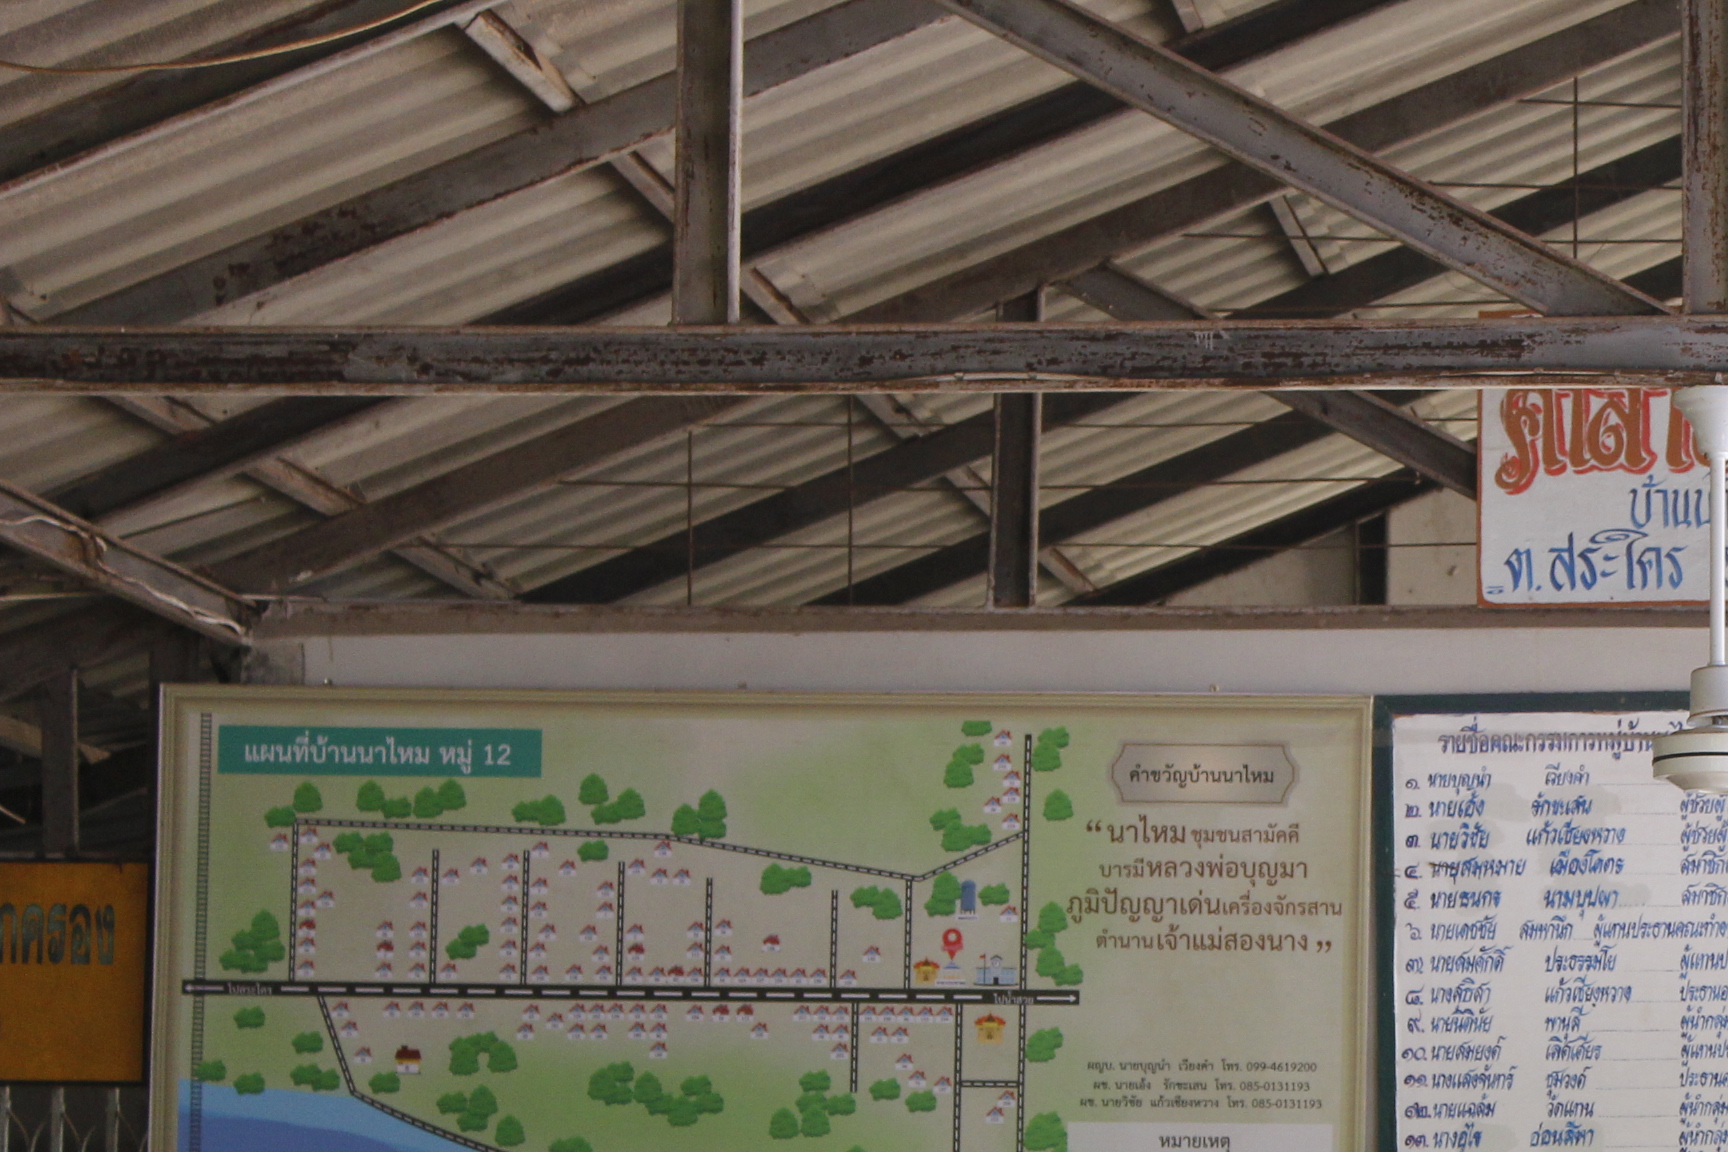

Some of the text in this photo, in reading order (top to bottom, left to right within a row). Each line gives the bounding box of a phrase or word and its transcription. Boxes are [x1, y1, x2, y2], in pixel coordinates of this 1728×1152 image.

[245, 731, 511, 775] แผนที่บ้านนาไหม หมู่ 12
[1129, 764, 1275, 788] คำขวัญบ้านนาไหม
